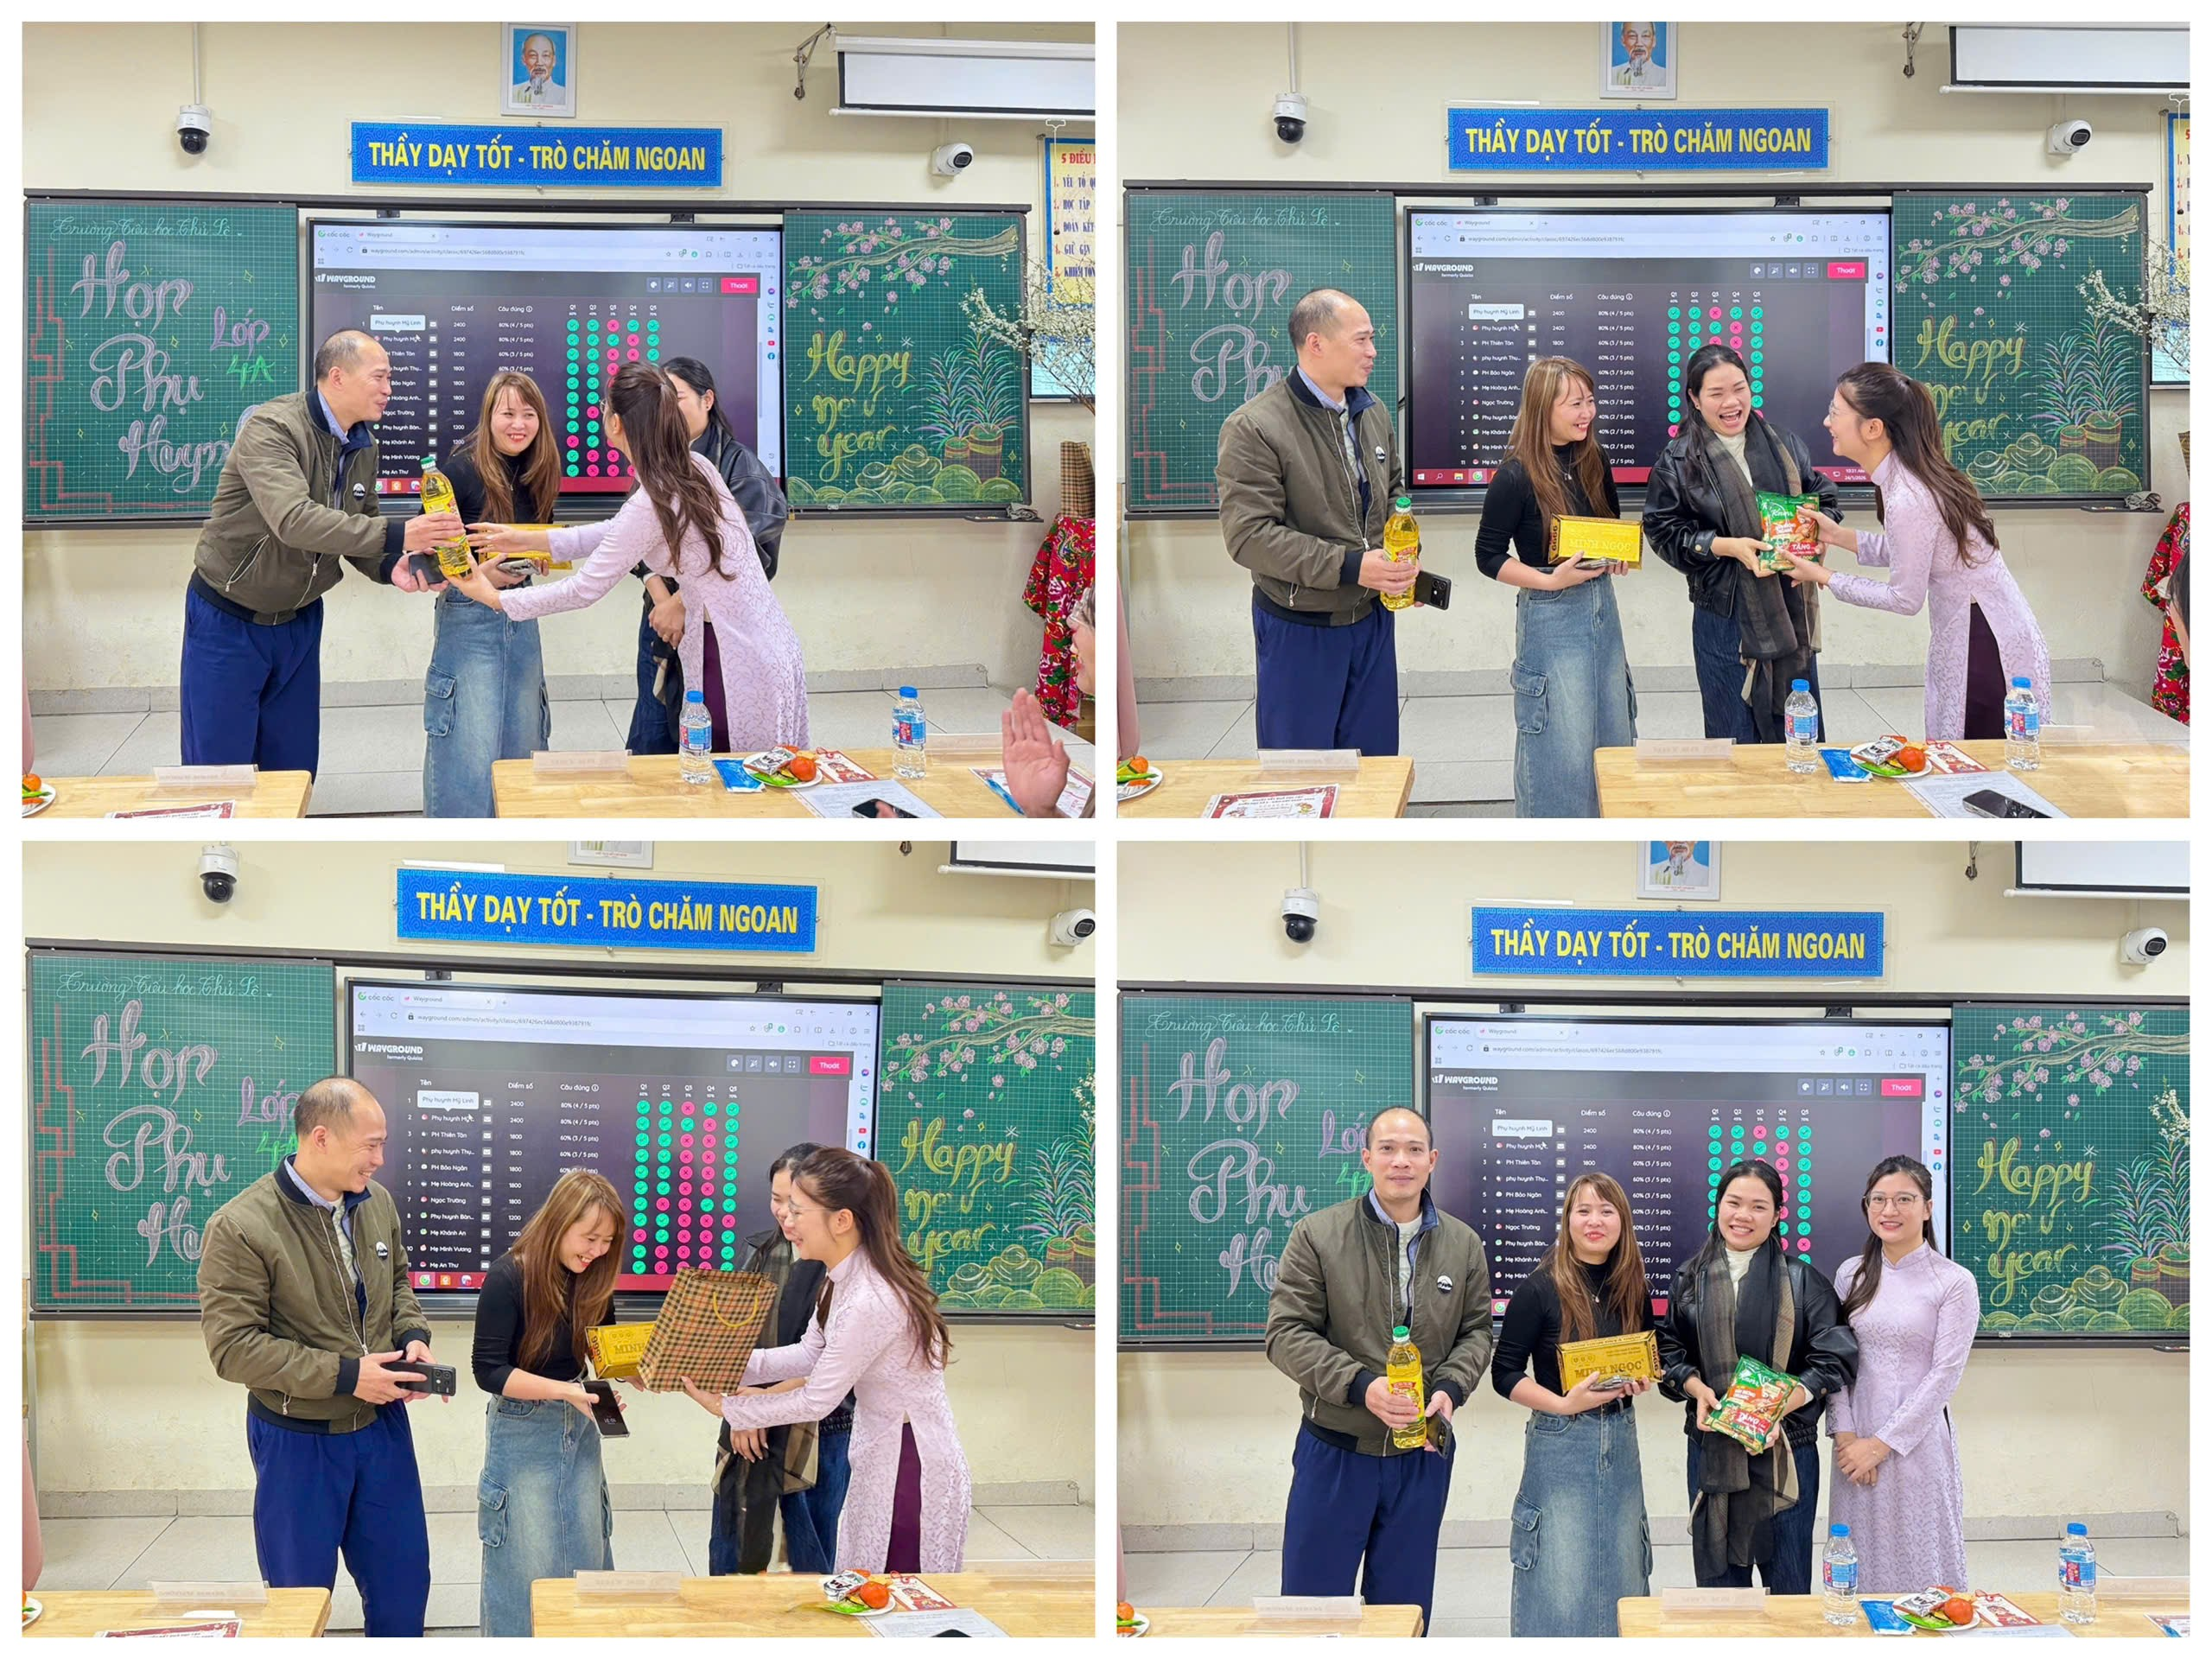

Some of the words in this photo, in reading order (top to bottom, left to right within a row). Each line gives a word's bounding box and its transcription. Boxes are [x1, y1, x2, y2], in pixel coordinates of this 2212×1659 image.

[368, 132, 422, 167] THẦY
[429, 143, 470, 175] DẠY
[475, 134, 513, 168] TỐT
[530, 140, 567, 170] TRÒ
[573, 140, 630, 170] CHĂM
[636, 147, 706, 170] NGOAN
[1061, 154, 1066, 163] 5
[1070, 148, 1090, 163] ĐIỀU
[1465, 118, 1520, 153] THẦY
[1526, 128, 1568, 161] DẠY
[1574, 117, 1612, 153] TỐT
[1630, 122, 1668, 153] TRÒ
[1674, 121, 1732, 153] CHĂM
[1738, 127, 1811, 153] NGOAN
[327, 275, 376, 283] WAYGROUND
[1424, 264, 1473, 272] WAYGROUND
[803, 329, 916, 394] Happy
[1912, 314, 2032, 381] Happy
[416, 881, 477, 921] THẦY
[485, 895, 531, 933] DẠY
[538, 886, 582, 926] TỐT
[600, 893, 642, 929] TRÒ
[649, 896, 712, 931] CHĂM
[719, 905, 798, 933] NGOAN
[1491, 918, 1550, 957] THẦY
[1556, 931, 1603, 965] DẠY
[1609, 919, 1650, 958] TỐT
[1669, 925, 1710, 958] TRÒ
[1717, 925, 1780, 959] CHĂM
[1787, 932, 1865, 960] NGOAN
[367, 1044, 423, 1054] WAYGROUND
[1444, 1075, 1497, 1085] WAYGROUND
[895, 1116, 1020, 1188] Happy
[1972, 1136, 2101, 1209] Happy
